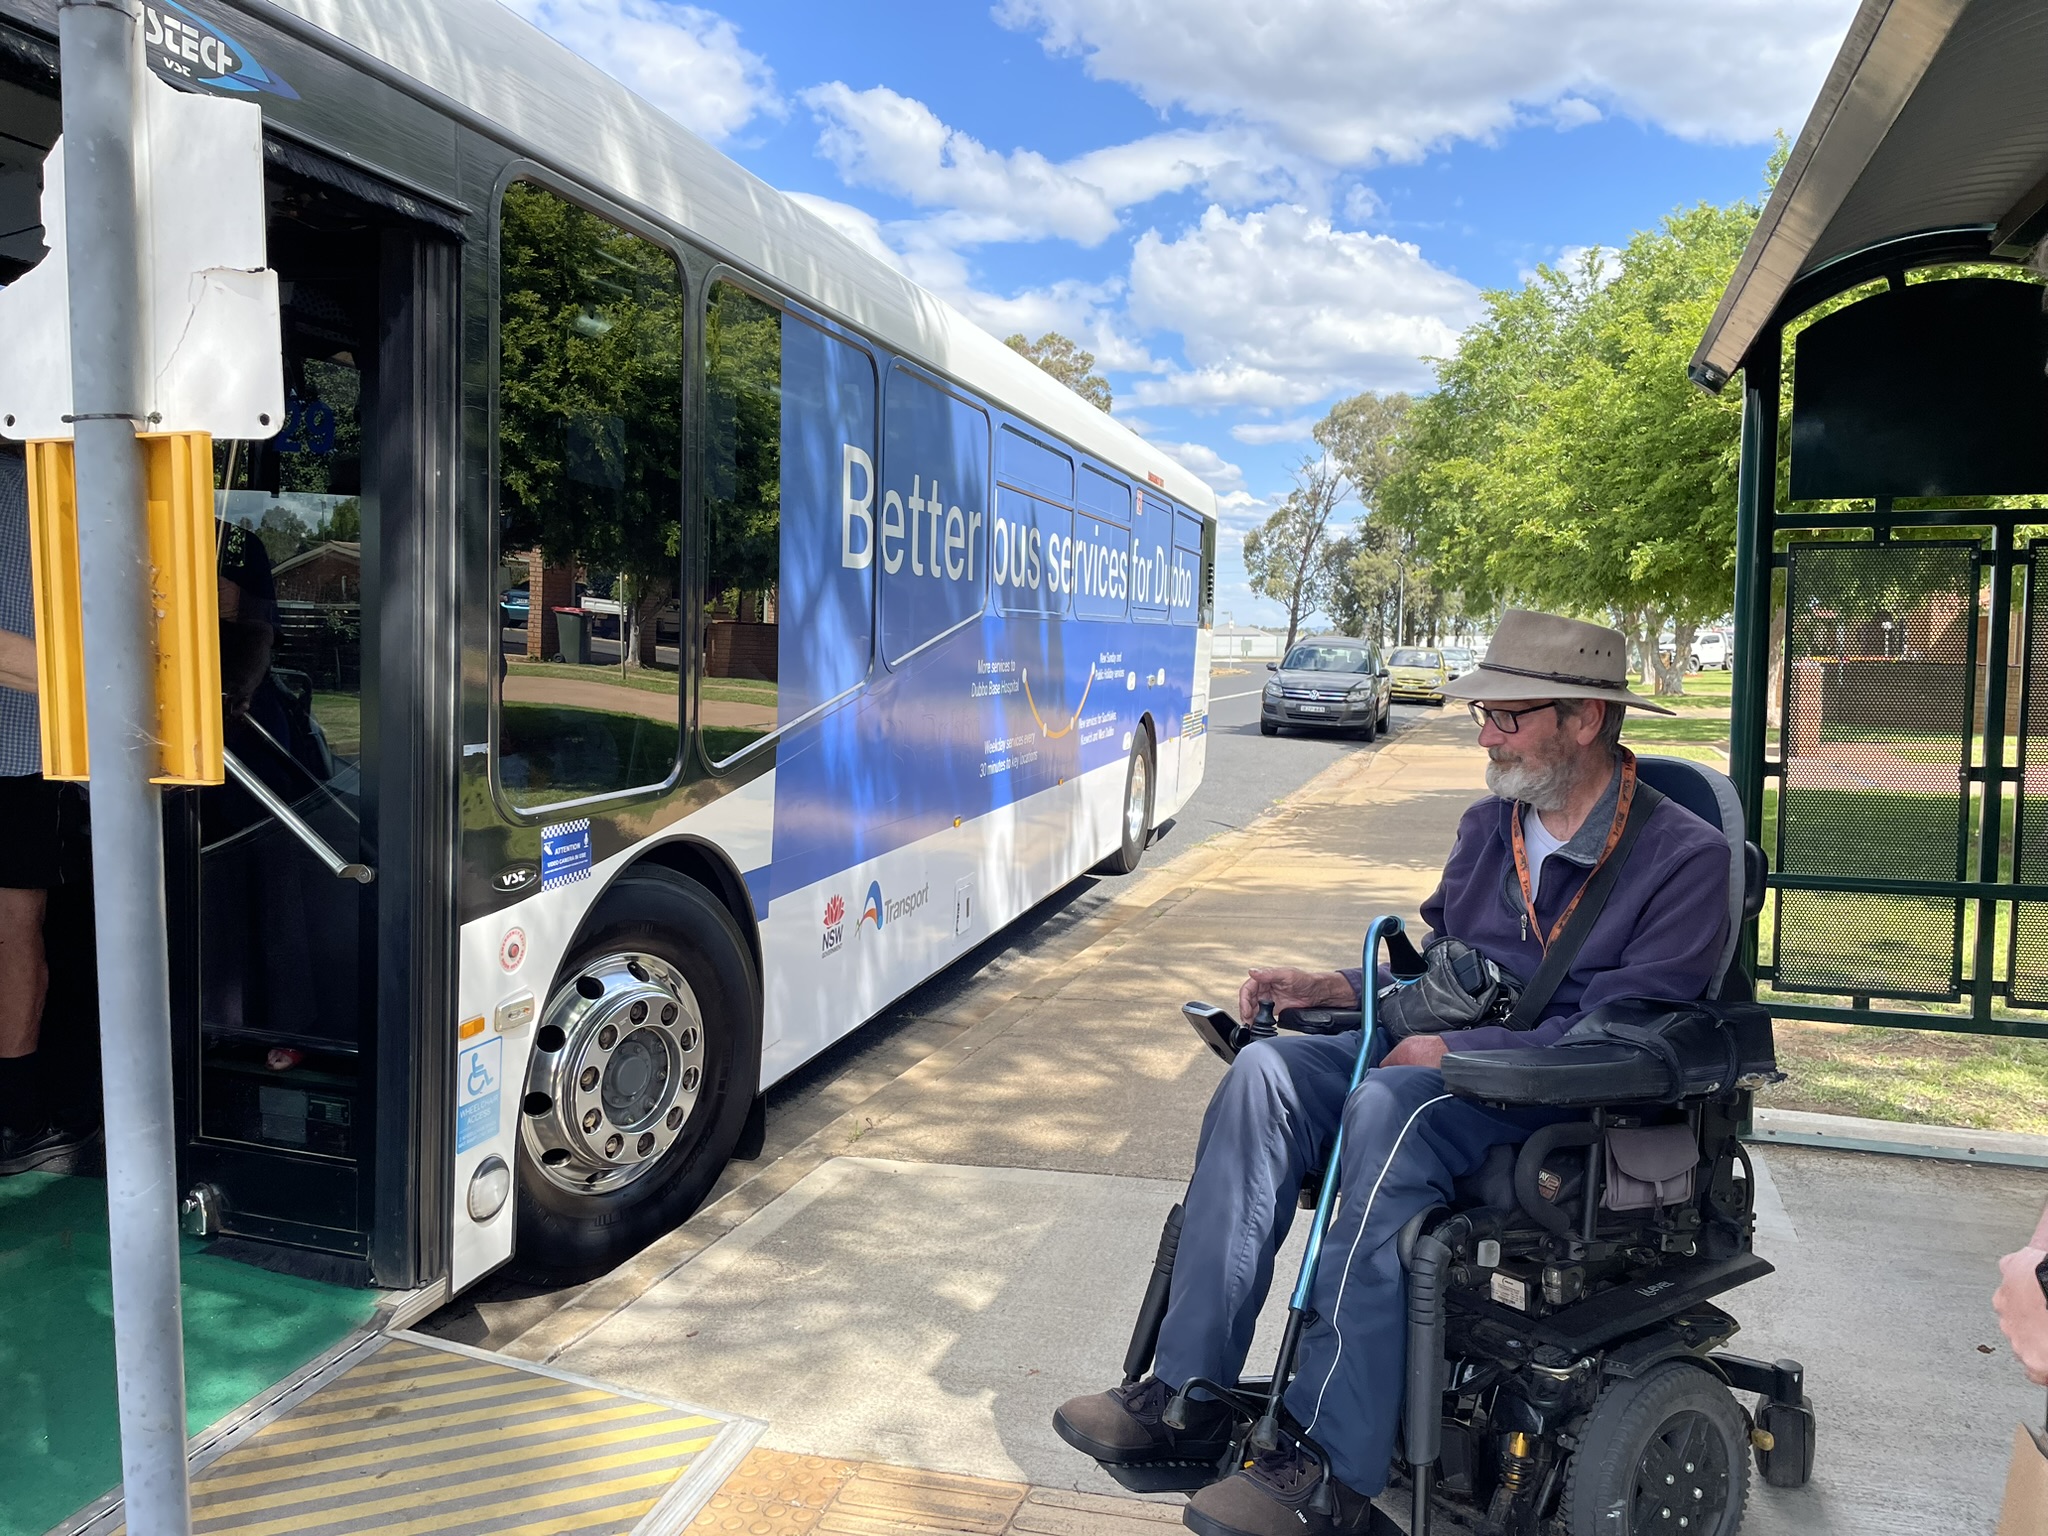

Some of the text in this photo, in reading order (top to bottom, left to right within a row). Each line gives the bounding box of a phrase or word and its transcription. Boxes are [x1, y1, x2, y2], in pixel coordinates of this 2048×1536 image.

[146, 6, 233, 75] STECH
[842, 443, 1192, 609] Better bus services for Dubbo
[977, 658, 1016, 674] More services to
[971, 678, 1020, 698] Dubbo Base Hospital
[984, 732, 1036, 755] Weekday services every
[979, 762, 987, 778] 30
[987, 759, 1006, 776] minutes
[1005, 757, 1011, 770] to
[1011, 754, 1020, 770] key
[554, 842, 581, 856] ATTENTION
[885, 882, 929, 924] Transport
[822, 924, 844, 951] NSW
[460, 1094, 499, 1118] WHEELCHAIR
[467, 1110, 491, 1124] ACCESS
